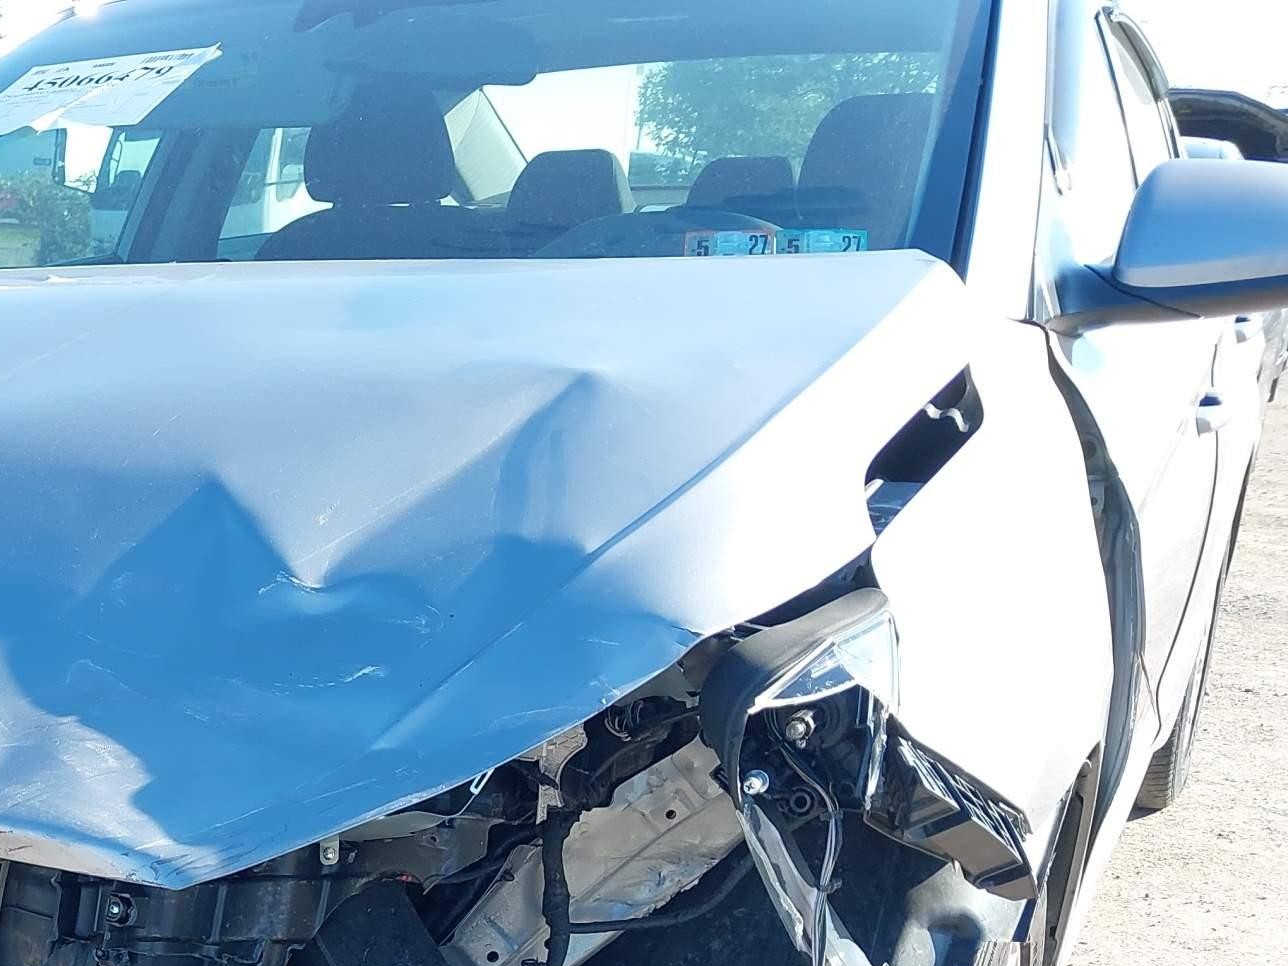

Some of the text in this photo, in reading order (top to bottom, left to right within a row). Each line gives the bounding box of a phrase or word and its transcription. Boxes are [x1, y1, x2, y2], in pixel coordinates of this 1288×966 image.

[22, 65, 174, 92] 45066479
[748, 234, 769, 255] 27
[841, 235, 861, 252] 27
